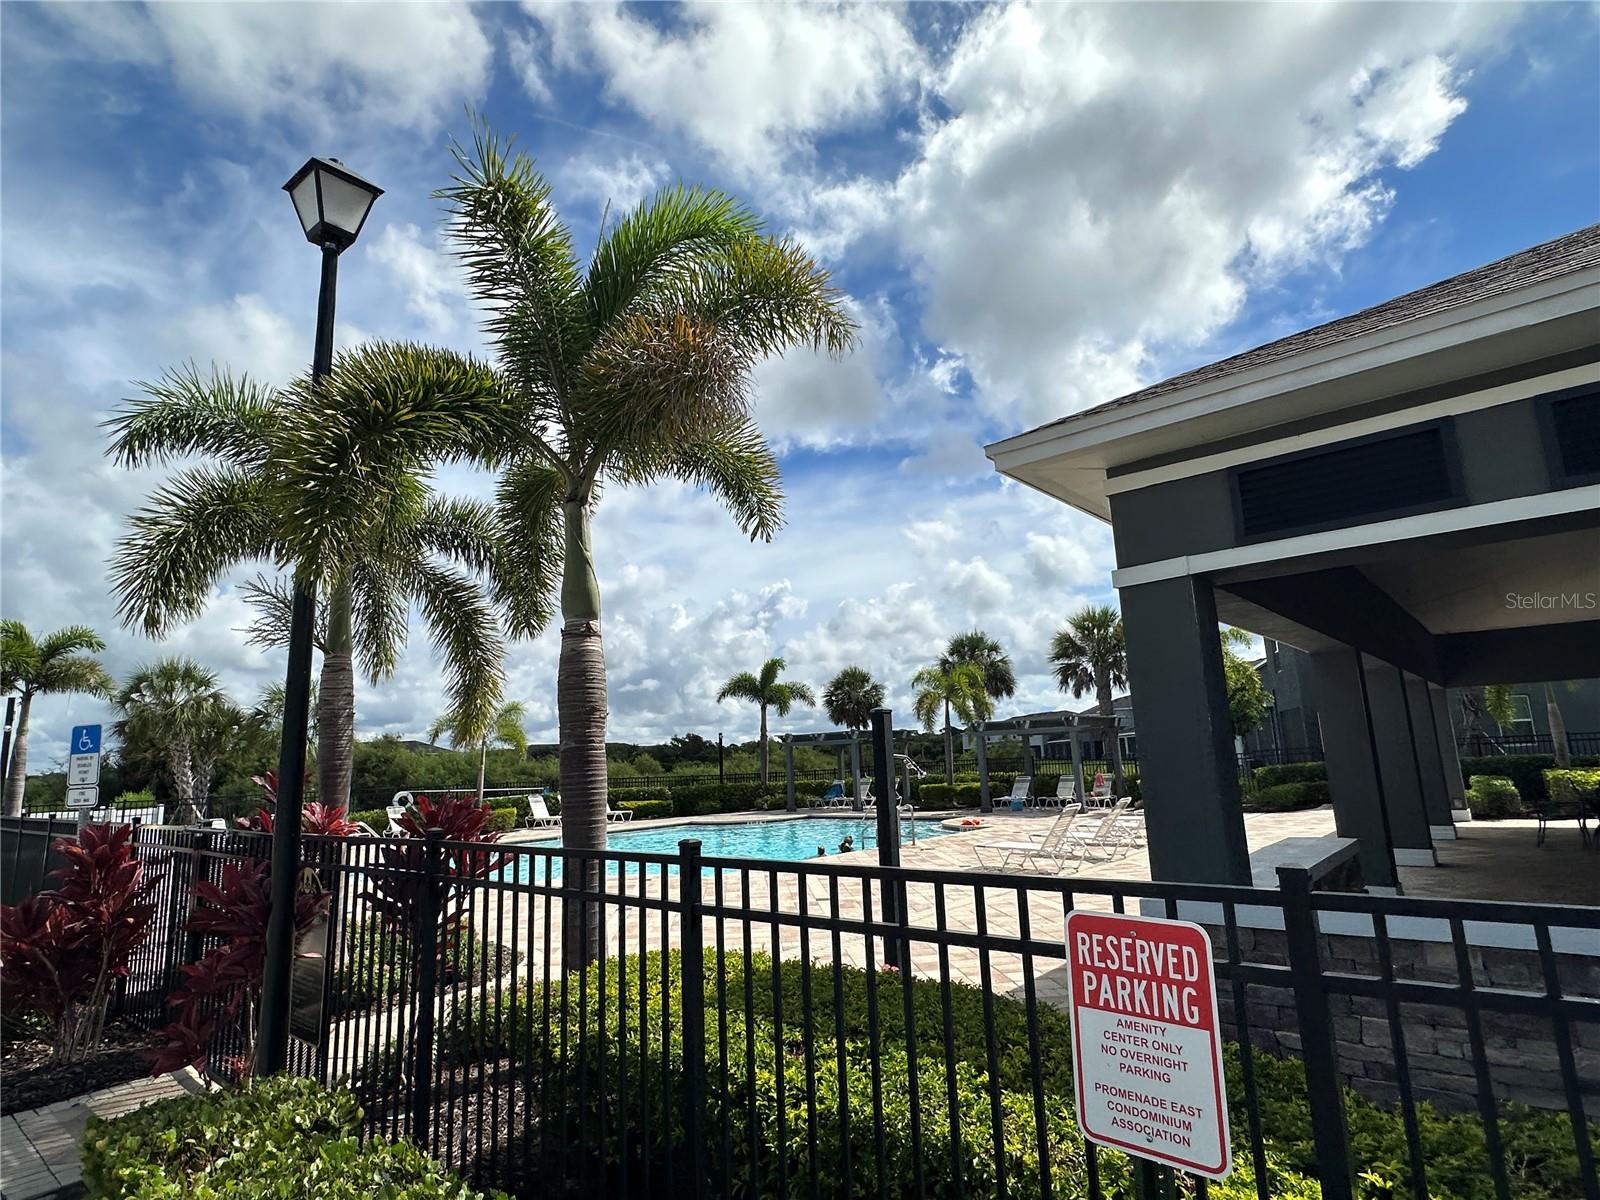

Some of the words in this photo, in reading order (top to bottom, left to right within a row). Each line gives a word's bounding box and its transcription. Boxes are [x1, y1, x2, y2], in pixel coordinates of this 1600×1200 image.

[1076, 931, 1199, 982] RESERVED
[1082, 970, 1200, 1025] PARKING
[1103, 1030, 1149, 1048] CENTER
[1151, 1040, 1183, 1056] ONLY
[1116, 1018, 1167, 1037] AMENITY
[1101, 1043, 1117, 1056] NO
[1120, 1048, 1188, 1072] OVERNIGHT
[1119, 1062, 1171, 1084] PARKING
[1094, 1082, 1168, 1110] PROMENADE
[1170, 1101, 1203, 1119] EAST
[1107, 1100, 1193, 1132] CONDOMINIUM
[1111, 1116, 1191, 1148] ASSOCIATION
